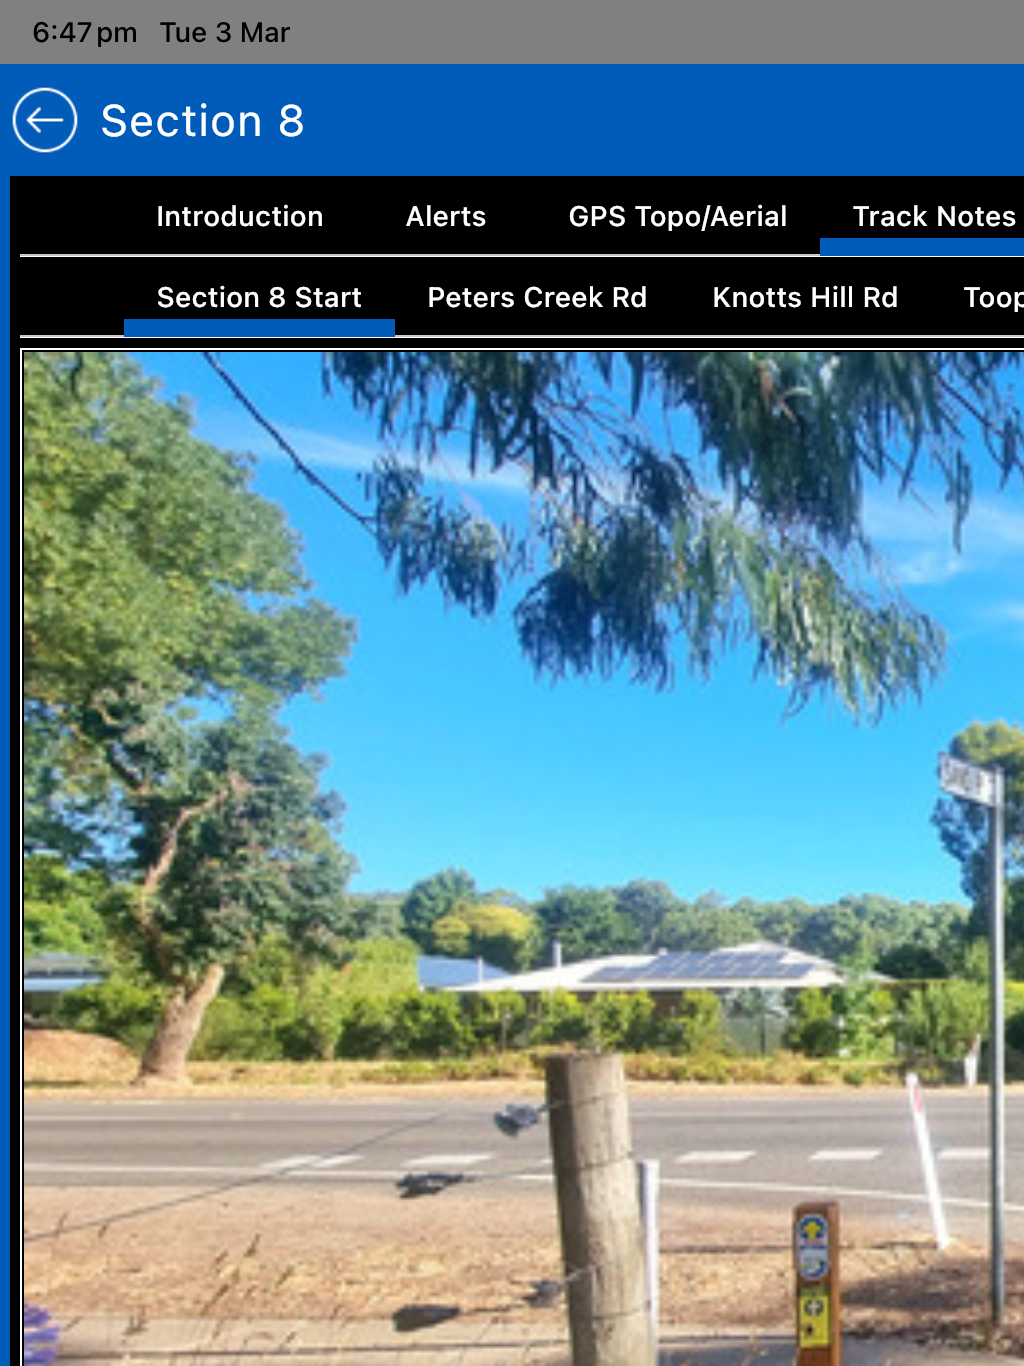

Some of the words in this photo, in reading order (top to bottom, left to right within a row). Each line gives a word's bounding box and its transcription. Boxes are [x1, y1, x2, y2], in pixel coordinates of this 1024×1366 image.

[160, 22, 206, 43] Tue
[216, 22, 231, 43] 3
[242, 22, 290, 43] Mar
[102, 103, 260, 137] Section
[280, 104, 303, 137] 8
[158, 205, 322, 227] Introduction
[406, 205, 486, 227] Alerts
[570, 205, 625, 227] GPS
[635, 205, 786, 231] Topo/Aerial
[853, 205, 927, 227] Track
[938, 206, 1016, 227] Notes
[157, 285, 258, 308] Section
[269, 286, 285, 308] 8
[296, 286, 361, 308] Start
[429, 287, 514, 308] Peters
[525, 286, 603, 308] Creek
[614, 286, 646, 308] Rd
[714, 287, 801, 308] Knotts
[812, 286, 852, 308] Hill
[865, 286, 897, 308] Rd
